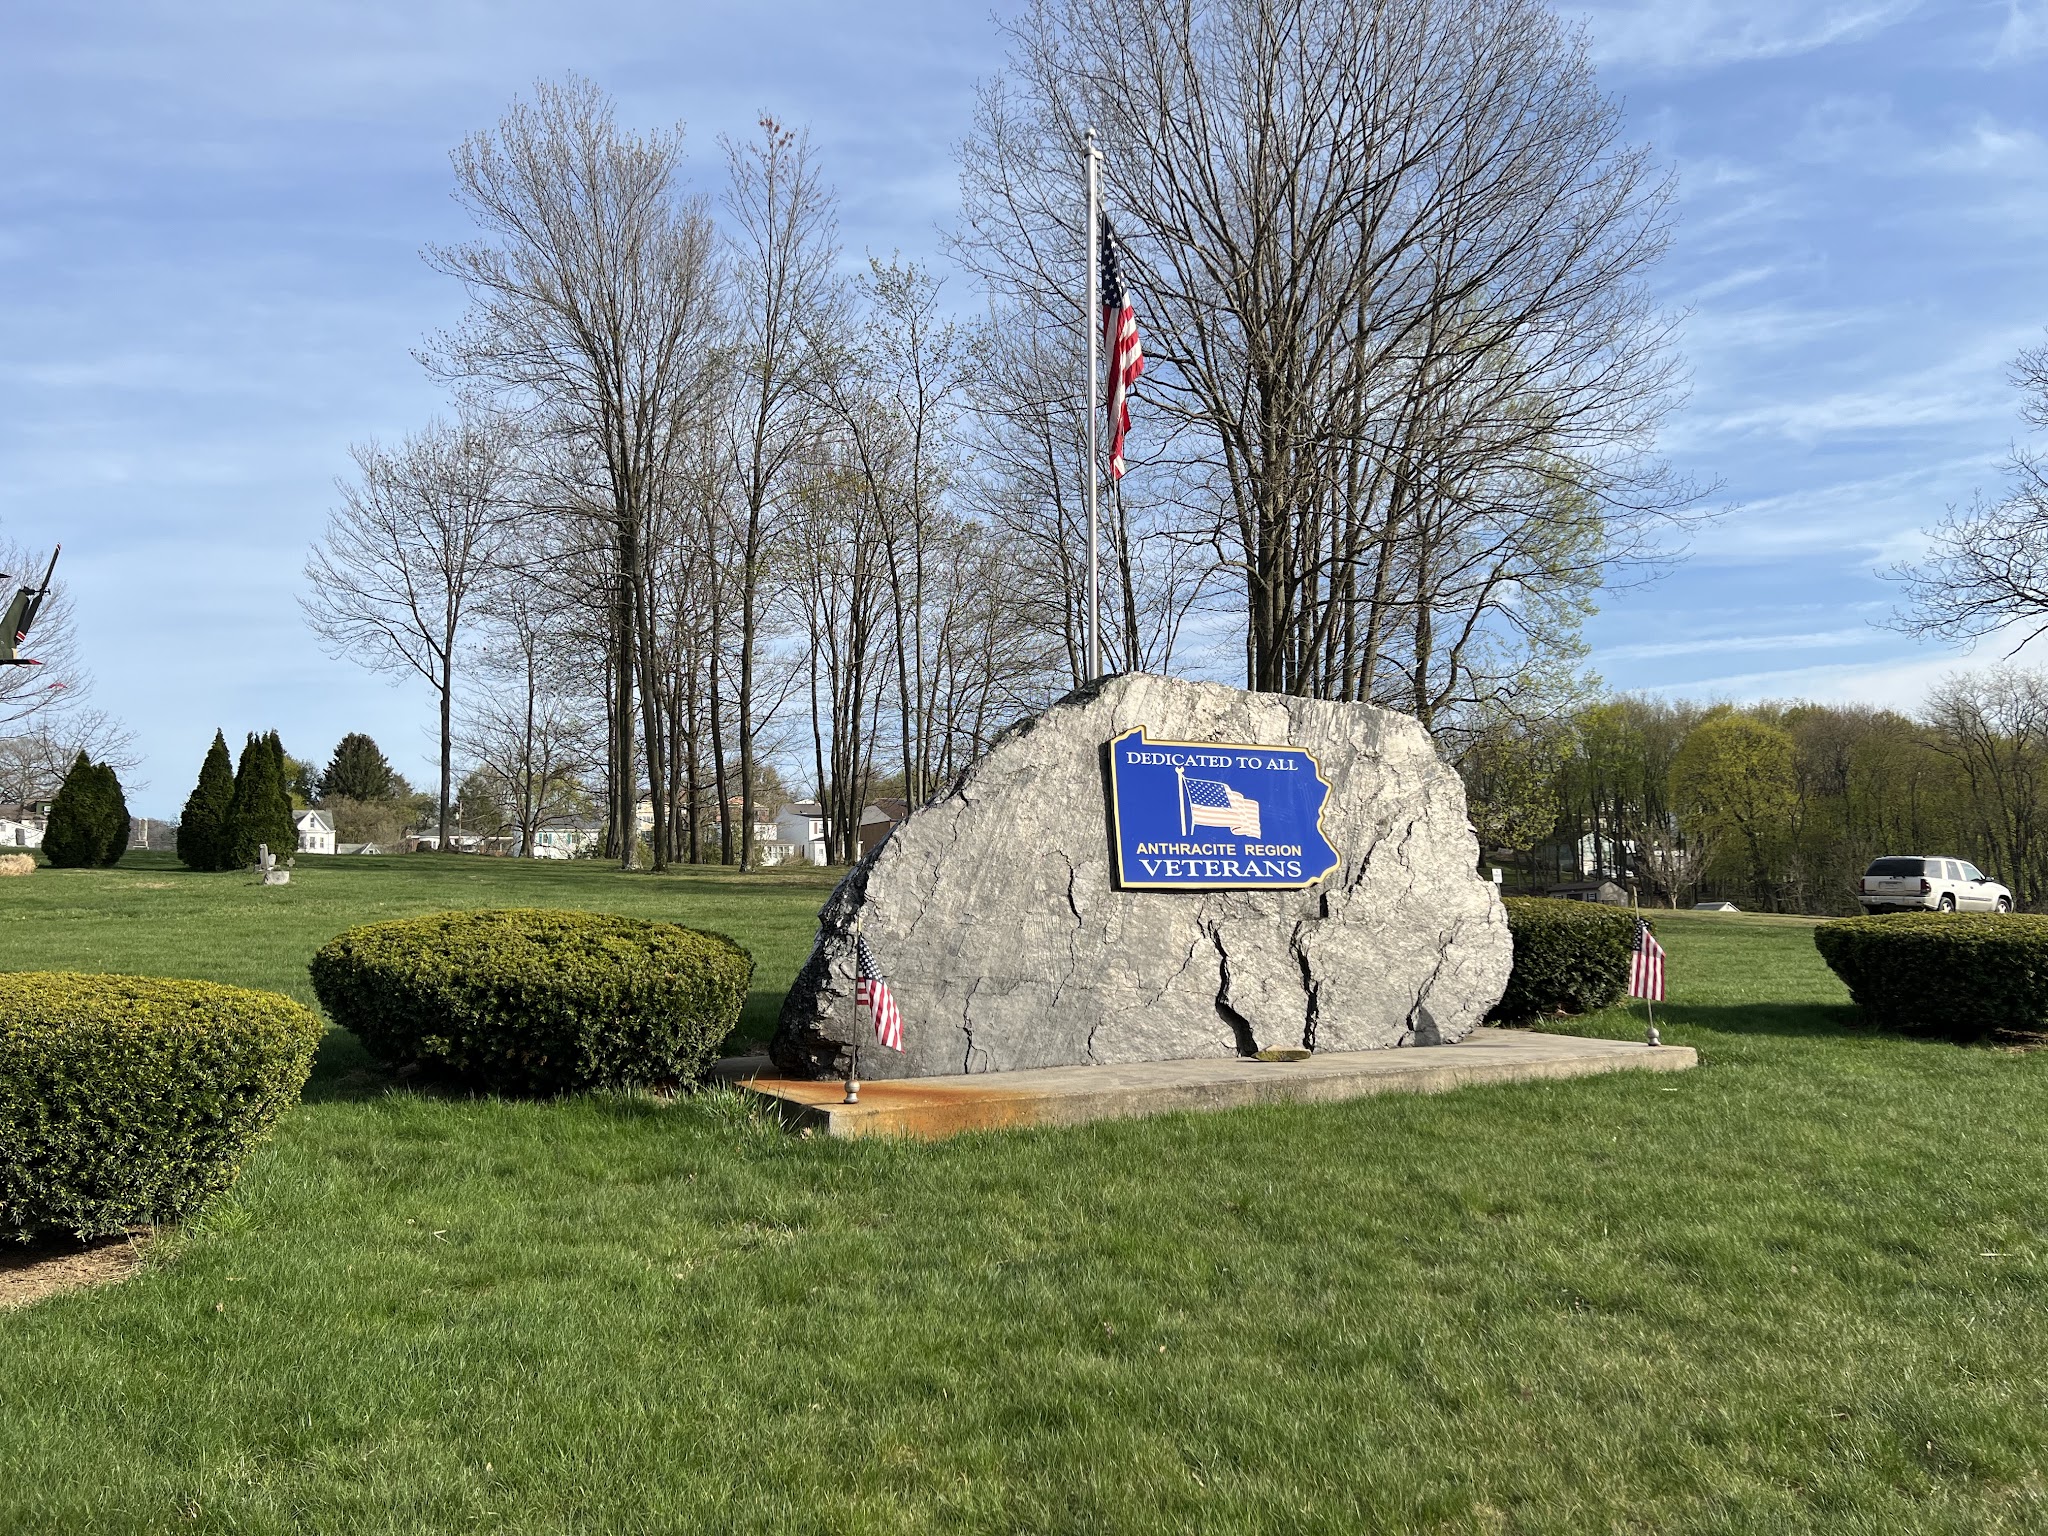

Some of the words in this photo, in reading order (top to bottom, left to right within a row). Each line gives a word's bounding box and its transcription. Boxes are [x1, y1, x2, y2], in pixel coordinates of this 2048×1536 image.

[1126, 752, 1232, 768] DEDICATED
[1236, 757, 1262, 770] TO
[1266, 758, 1298, 771] ALL
[1136, 843, 1236, 856] ANTHRACITE
[1244, 845, 1302, 857] REGION
[1139, 859, 1302, 877] VETERANS
